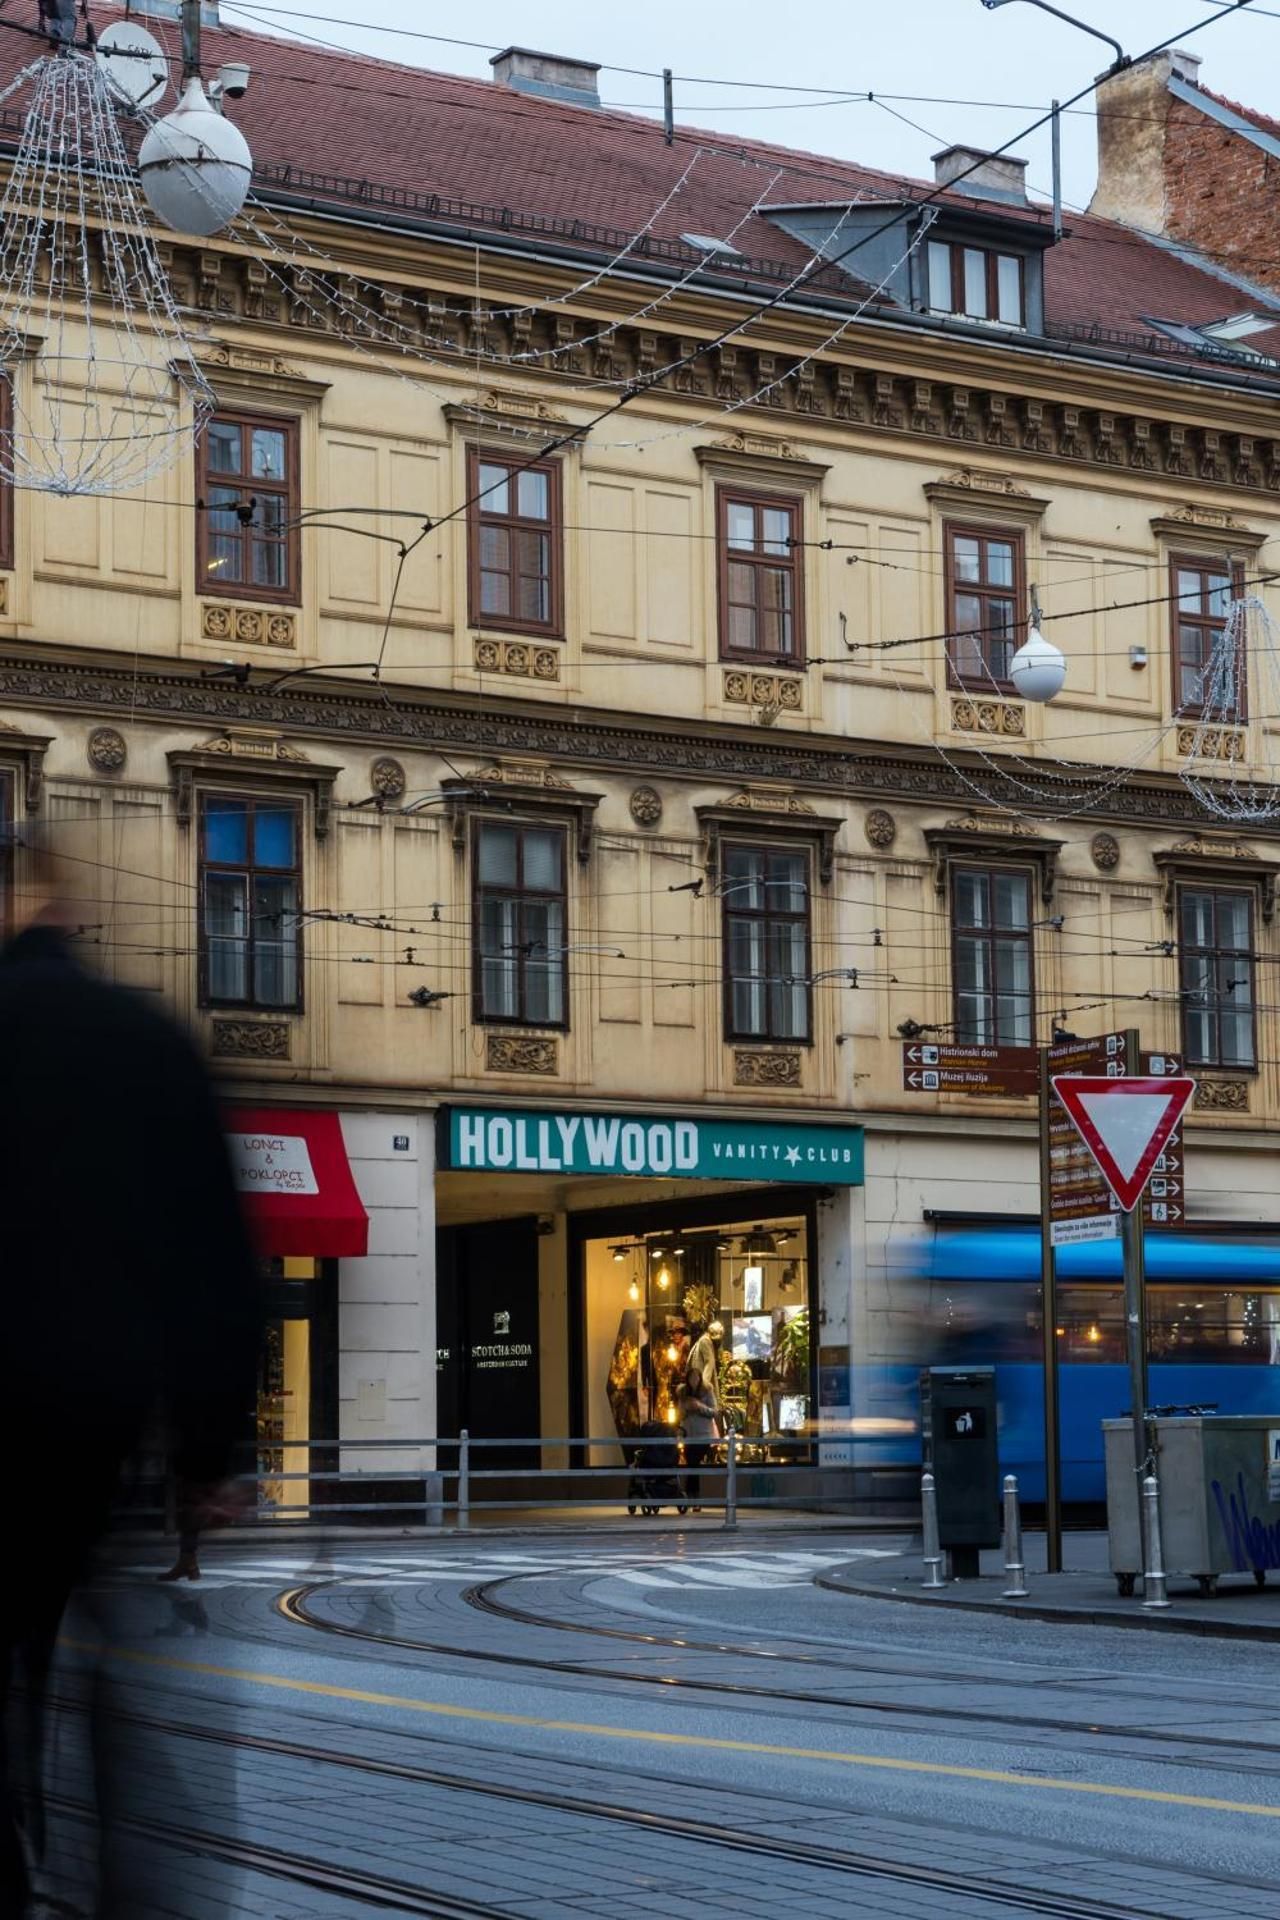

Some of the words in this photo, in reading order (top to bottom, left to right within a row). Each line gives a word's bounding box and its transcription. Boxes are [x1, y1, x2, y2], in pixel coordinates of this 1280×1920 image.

[940, 1046, 980, 1058] Histrionski
[981, 1048, 998, 1058] dom
[940, 1072, 964, 1083] Muzej
[243, 1139, 287, 1151] LONCI
[459, 1115, 699, 1172] HOLLYWOOD
[265, 1153, 273, 1164] &
[713, 1143, 780, 1162] VANITY
[808, 1147, 852, 1163] CLUB
[240, 1168, 304, 1182] POKLOPCI
